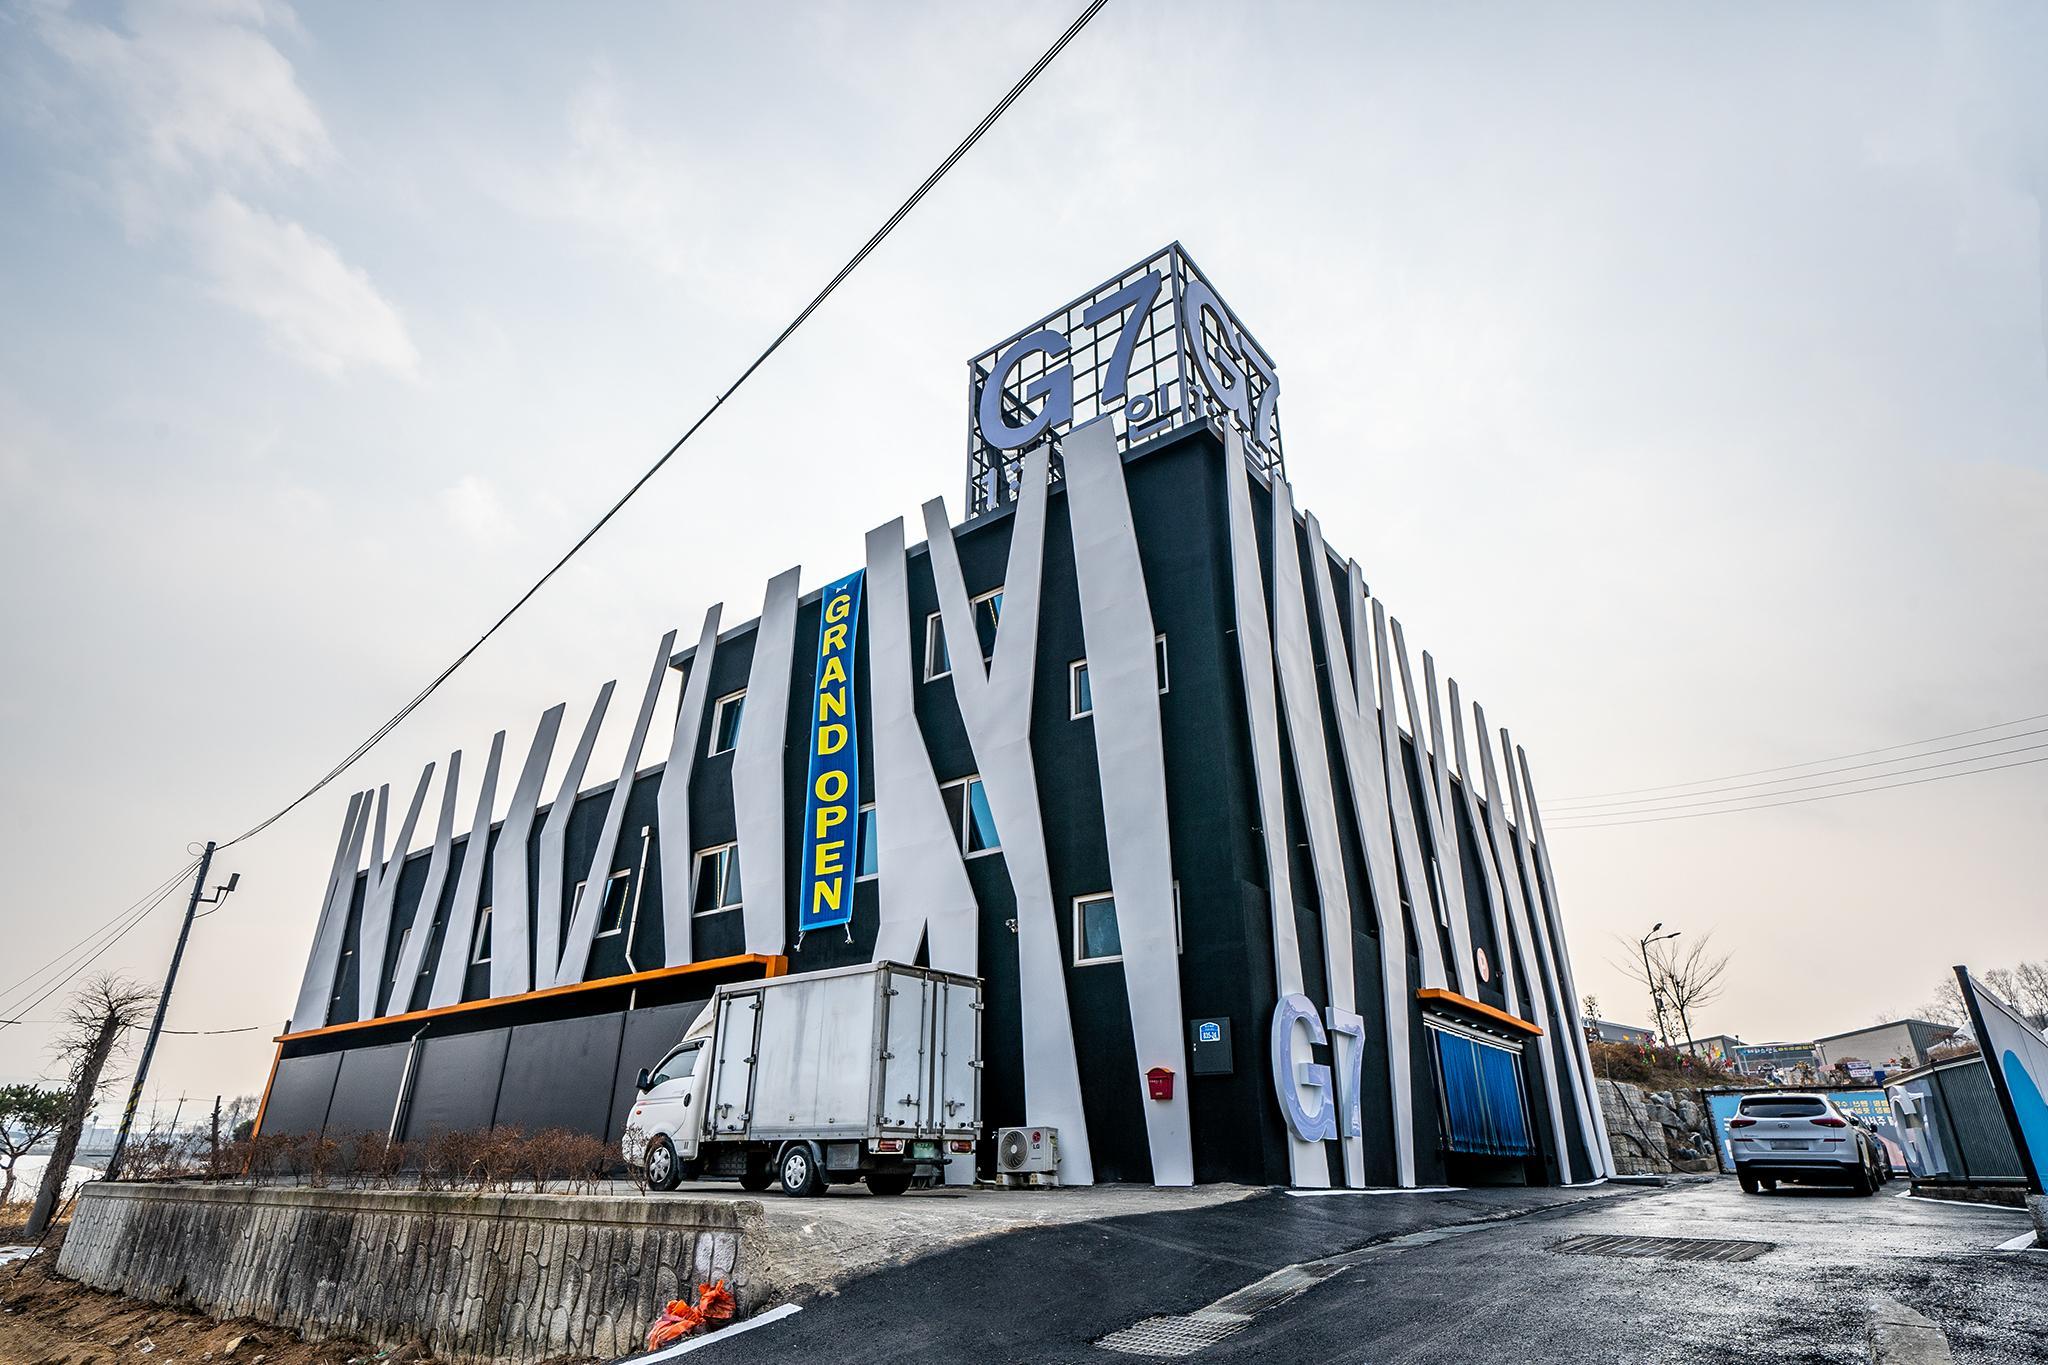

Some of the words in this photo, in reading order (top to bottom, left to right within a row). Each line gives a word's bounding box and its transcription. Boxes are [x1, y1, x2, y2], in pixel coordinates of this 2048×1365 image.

[980, 269, 1162, 450] G7
[1183, 280, 1279, 454] G7
[817, 594, 851, 756] GRAND
[812, 770, 849, 915] OPEN
[1271, 992, 1366, 1143] G7
